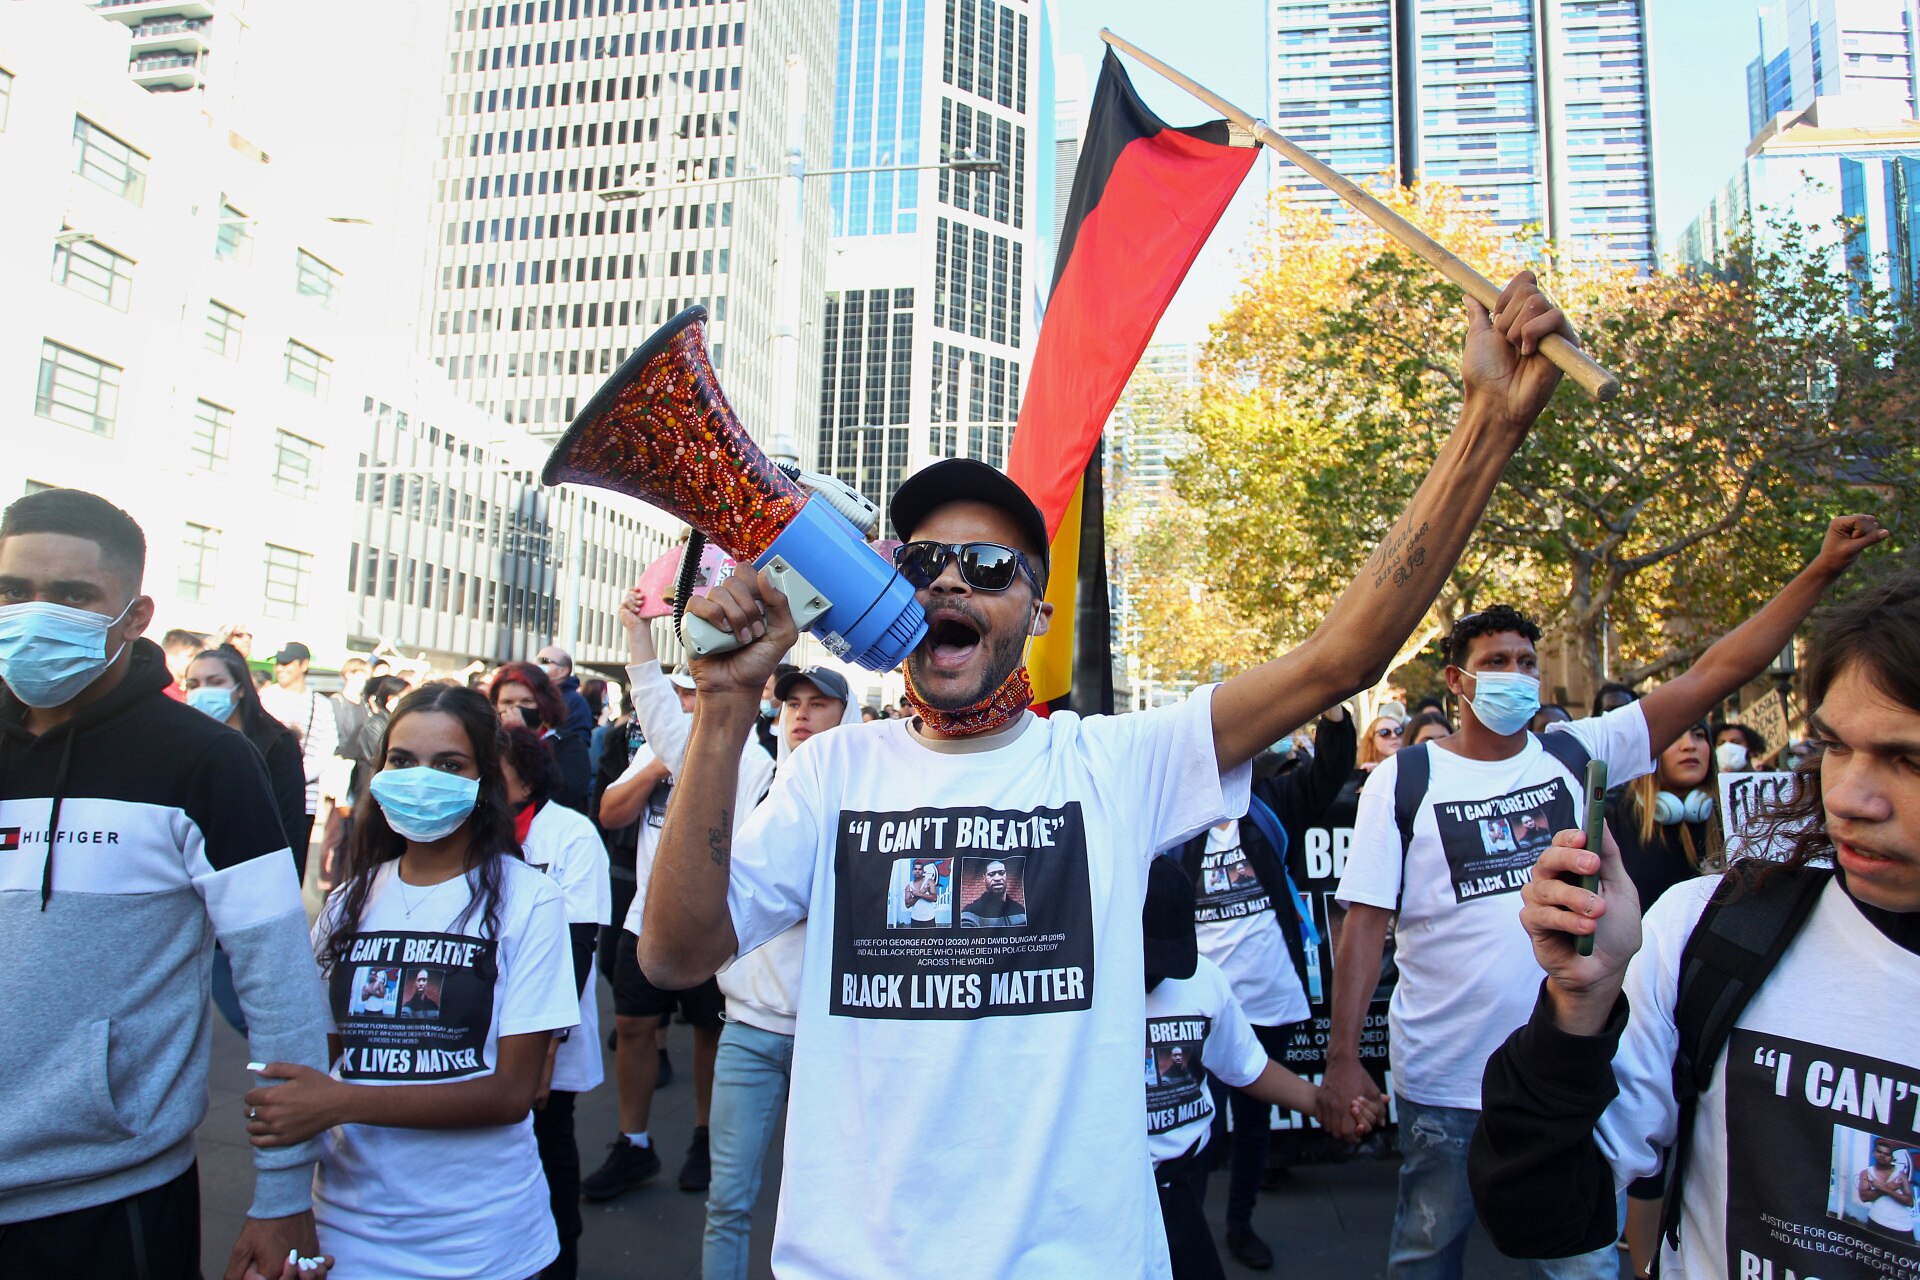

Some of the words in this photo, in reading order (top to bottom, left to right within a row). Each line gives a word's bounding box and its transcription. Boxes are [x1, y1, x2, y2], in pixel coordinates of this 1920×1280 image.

[707, 408, 782, 502] CUSTODY
[1499, 782, 1559, 816] BREATHE”
[23, 831, 119, 844] HILFIGER
[849, 820, 872, 852] “I
[878, 817, 948, 854] CAN’T
[1459, 875, 1506, 898] BLACK
[1220, 903, 1247, 918] LIVES
[350, 938, 400, 963] CAN’T
[867, 948, 880, 956] ALL
[880, 948, 905, 956] BLACK
[906, 948, 932, 956] PEOPLE
[933, 948, 953, 956] WHO
[954, 948, 975, 956] HAVE
[975, 947, 992, 955] DIED
[1002, 945, 1027, 954] POLICE
[1027, 943, 1059, 952] CUSTODY
[872, 938, 888, 947] FOR
[889, 938, 920, 947] GEORGE
[920, 938, 944, 946] FLOYD
[945, 938, 970, 947] (2020)
[987, 937, 1009, 945] DAVID
[1009, 935, 1038, 944] DUNGAY
[1038, 934, 1048, 942] JR
[1048, 933, 1066, 941] (2015)
[917, 958, 949, 966] ACROSS
[950, 958, 966, 966] THE
[967, 957, 995, 965] WORLD
[842, 973, 904, 1009] BLACK
[910, 973, 982, 1009] LIVES
[989, 966, 1086, 1007] MATTER
[360, 1048, 411, 1073] LIVES
[415, 1047, 479, 1073] MATTER
[1287, 1049, 1320, 1061] ROSS
[1359, 1046, 1387, 1058] ORLD
[1753, 1046, 1792, 1097] “I
[1147, 1108, 1175, 1131] IVES
[1760, 1213, 1801, 1235] JUSTICE
[1803, 1226, 1826, 1239] FOR
[1827, 1231, 1881, 1258] GEORGE
[1884, 1251, 1920, 1271] FLOY
[1770, 1229, 1790, 1244] AND
[1792, 1238, 1814, 1251] ALL
[1815, 1241, 1853, 1258] BLACK
[1855, 1252, 1906, 1280] PEOPLE
